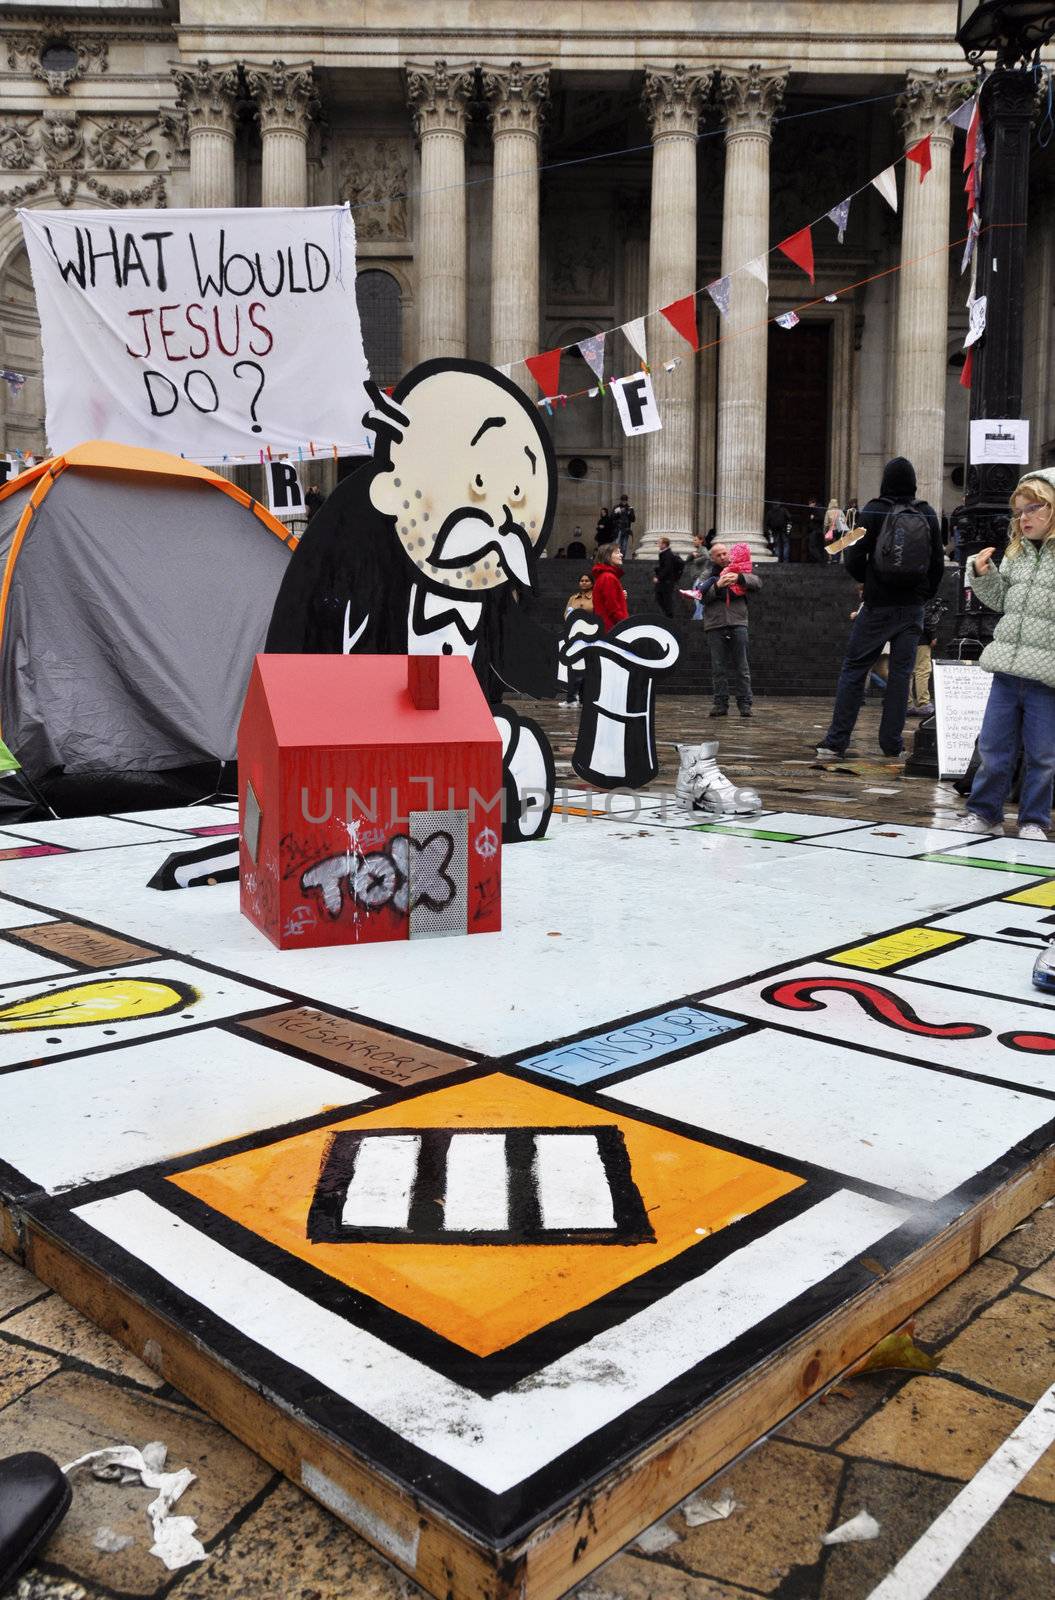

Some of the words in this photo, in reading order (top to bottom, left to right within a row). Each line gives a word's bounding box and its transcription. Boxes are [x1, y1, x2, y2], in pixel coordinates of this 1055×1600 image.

[43, 225, 174, 292] WHAT
[189, 228, 331, 298] WOULD
[126, 302, 274, 362] JESUS
[622, 378, 648, 428] F
[271, 462, 302, 508] R
[529, 1008, 719, 1081] FINSBURY
